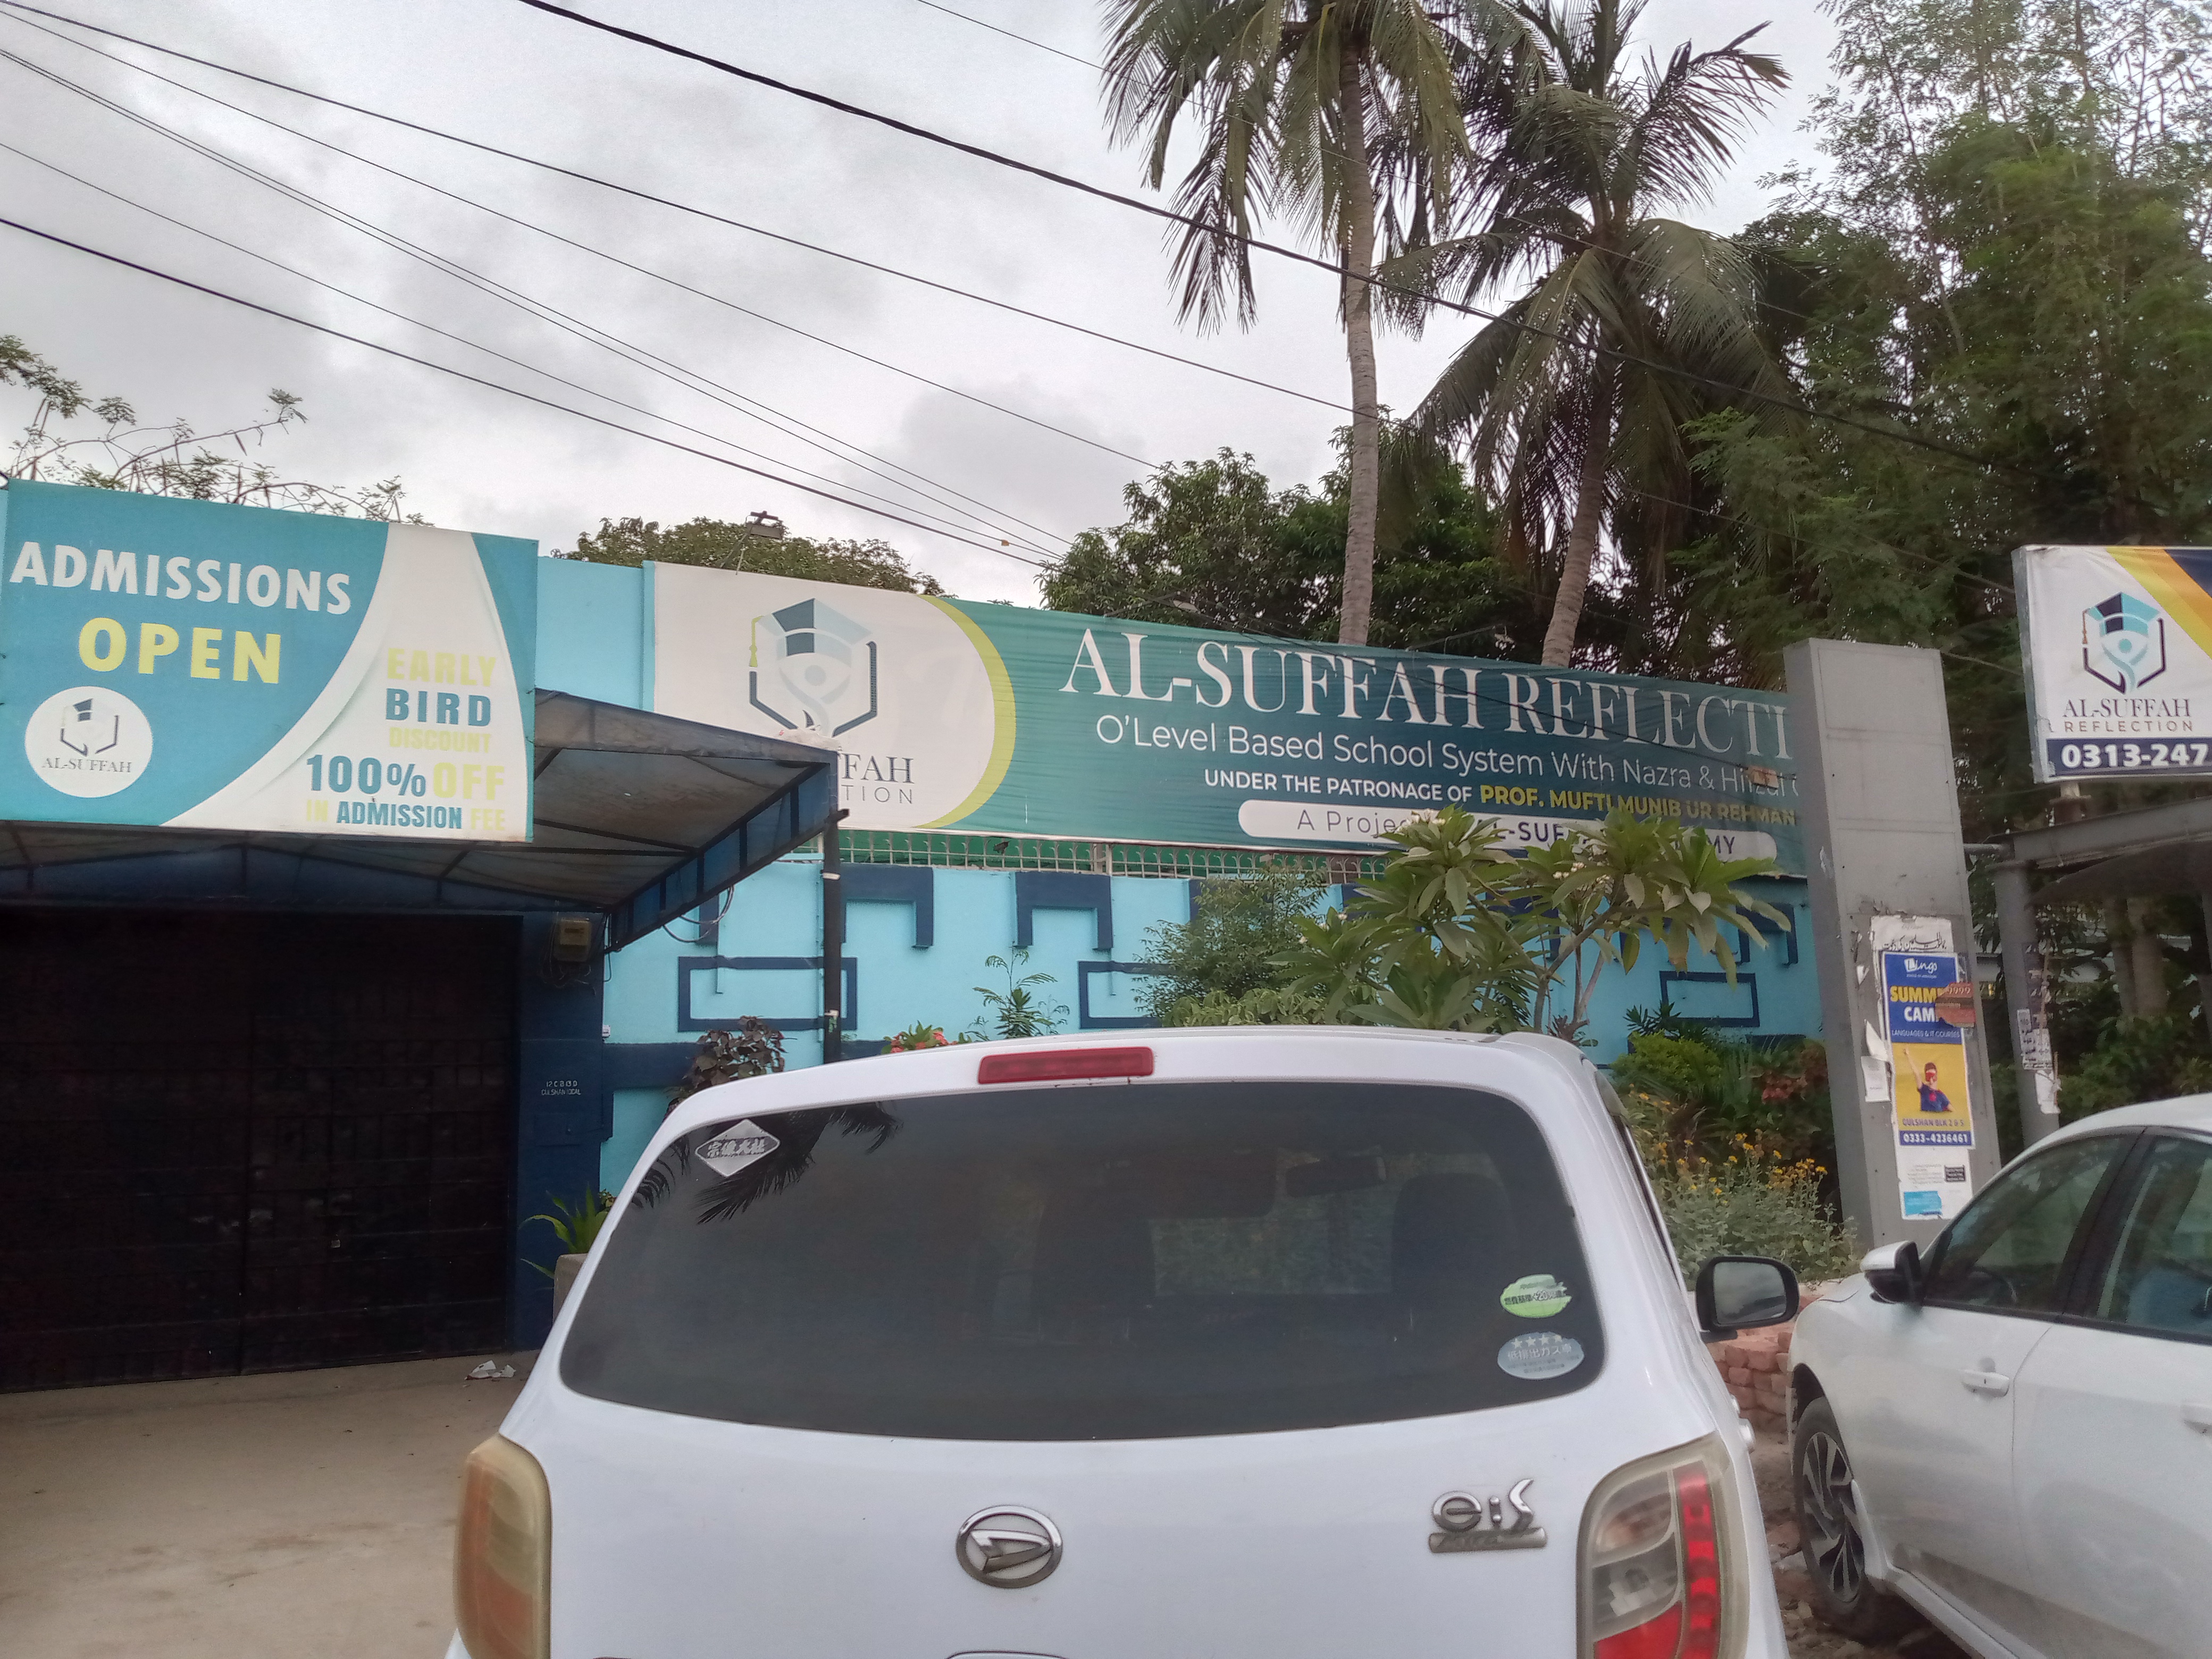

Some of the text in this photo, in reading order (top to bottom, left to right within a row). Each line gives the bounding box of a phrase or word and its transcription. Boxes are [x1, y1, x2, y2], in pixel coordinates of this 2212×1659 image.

[10, 541, 351, 615] ADMISSIONS
[78, 617, 281, 684] OPEN
[387, 648, 496, 687] EARLY
[386, 688, 491, 726] BIRD
[1058, 629, 1794, 759] AL-SUFFAH REFLECTI
[2063, 698, 2191, 718] AL-SUFFAH
[389, 726, 492, 753] DISCOUNT
[2064, 720, 2193, 733] REFLECTION
[41, 757, 133, 773] AL-SUFFAH
[1096, 714, 1217, 752] O'Level
[1228, 724, 1323, 760] Based
[1334, 733, 1433, 768] School
[1442, 742, 1543, 777] System
[1551, 751, 1614, 782] With
[1623, 758, 1691, 789] Nazra
[1699, 765, 1715, 790] &
[2061, 743, 2208, 769] 0313-247
[307, 754, 505, 800] 100% OFF
[838, 753, 915, 784] FAH
[1204, 768, 1797, 825] UNDER THE PATRONAGE OF PROF. MUFTI MUNIB UR REHMAN
[306, 799, 505, 831] IN ADMISSION FEE
[1297, 809, 1314, 831] A
[1904, 1006, 1940, 1023] CAM
